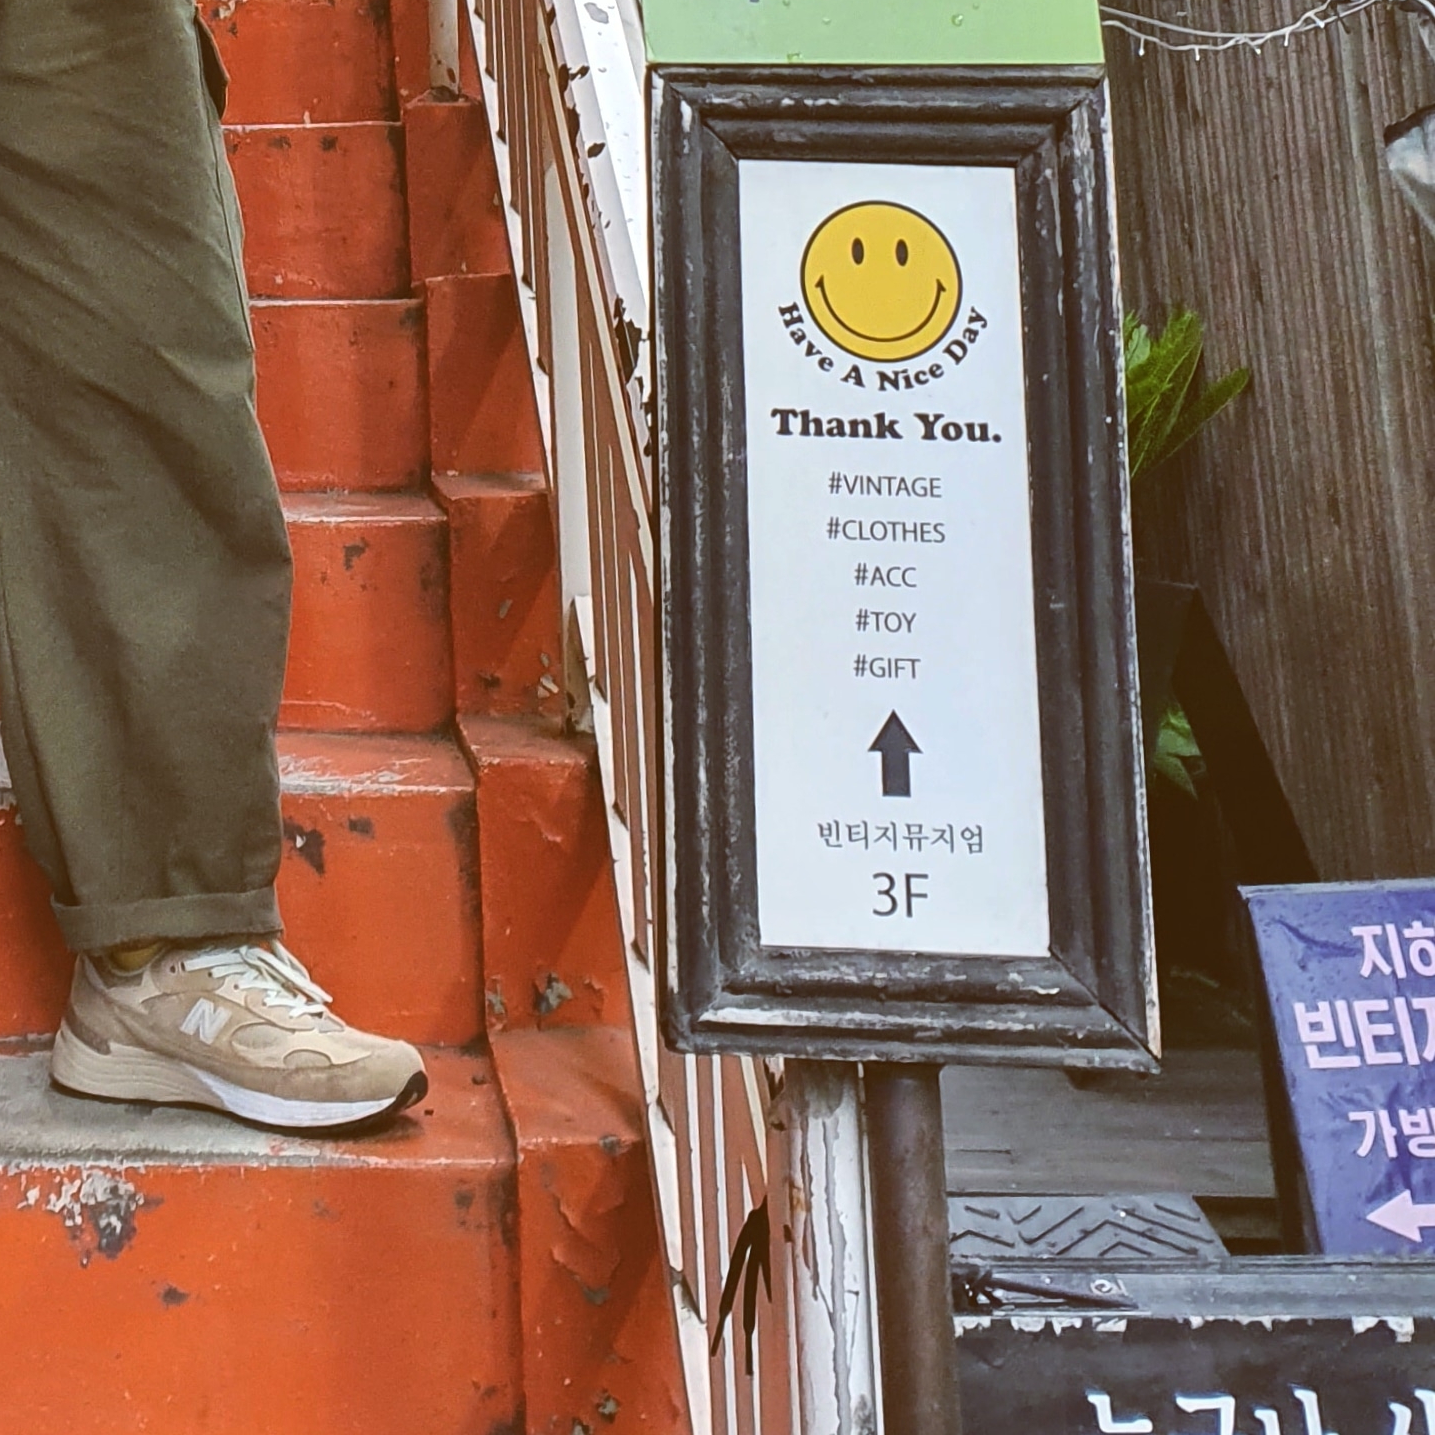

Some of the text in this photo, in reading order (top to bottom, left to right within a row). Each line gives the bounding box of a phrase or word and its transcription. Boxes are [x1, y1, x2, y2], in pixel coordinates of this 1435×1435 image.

[778, 301, 989, 391] Have A Nice Day
[770, 408, 1002, 443] Thank You.
[828, 471, 943, 498] #VINTAGE
[826, 517, 946, 543] #CLOTHES
[854, 563, 917, 588] #ACC
[855, 608, 917, 633] #TOY
[853, 654, 921, 679] #GIFT
[817, 820, 984, 855] 빈티지뮤지엄
[871, 871, 929, 918] 3F
[179, 997, 233, 1045] N
